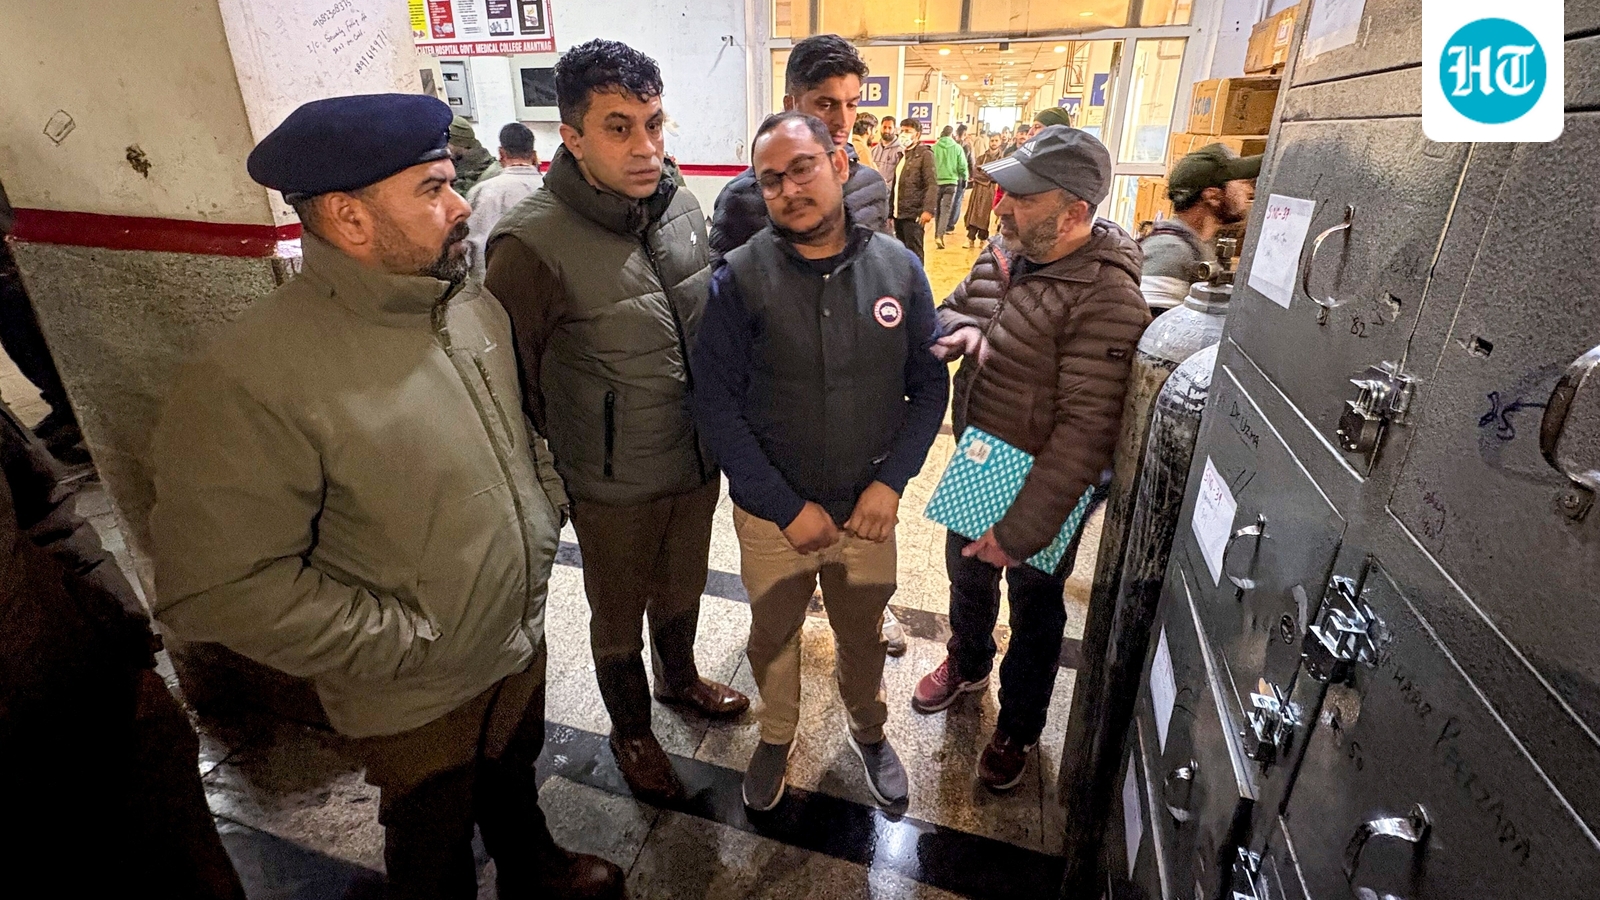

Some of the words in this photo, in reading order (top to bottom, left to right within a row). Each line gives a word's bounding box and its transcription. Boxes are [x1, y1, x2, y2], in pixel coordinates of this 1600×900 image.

[435, 44, 460, 55] HOSPITAL
[460, 44, 476, 54] GOVT.
[475, 43, 500, 53] MEDICAL
[500, 42, 523, 52] COLLEGE
[523, 40, 553, 51] ANANTNAG
[911, 106, 929, 118] 2B
